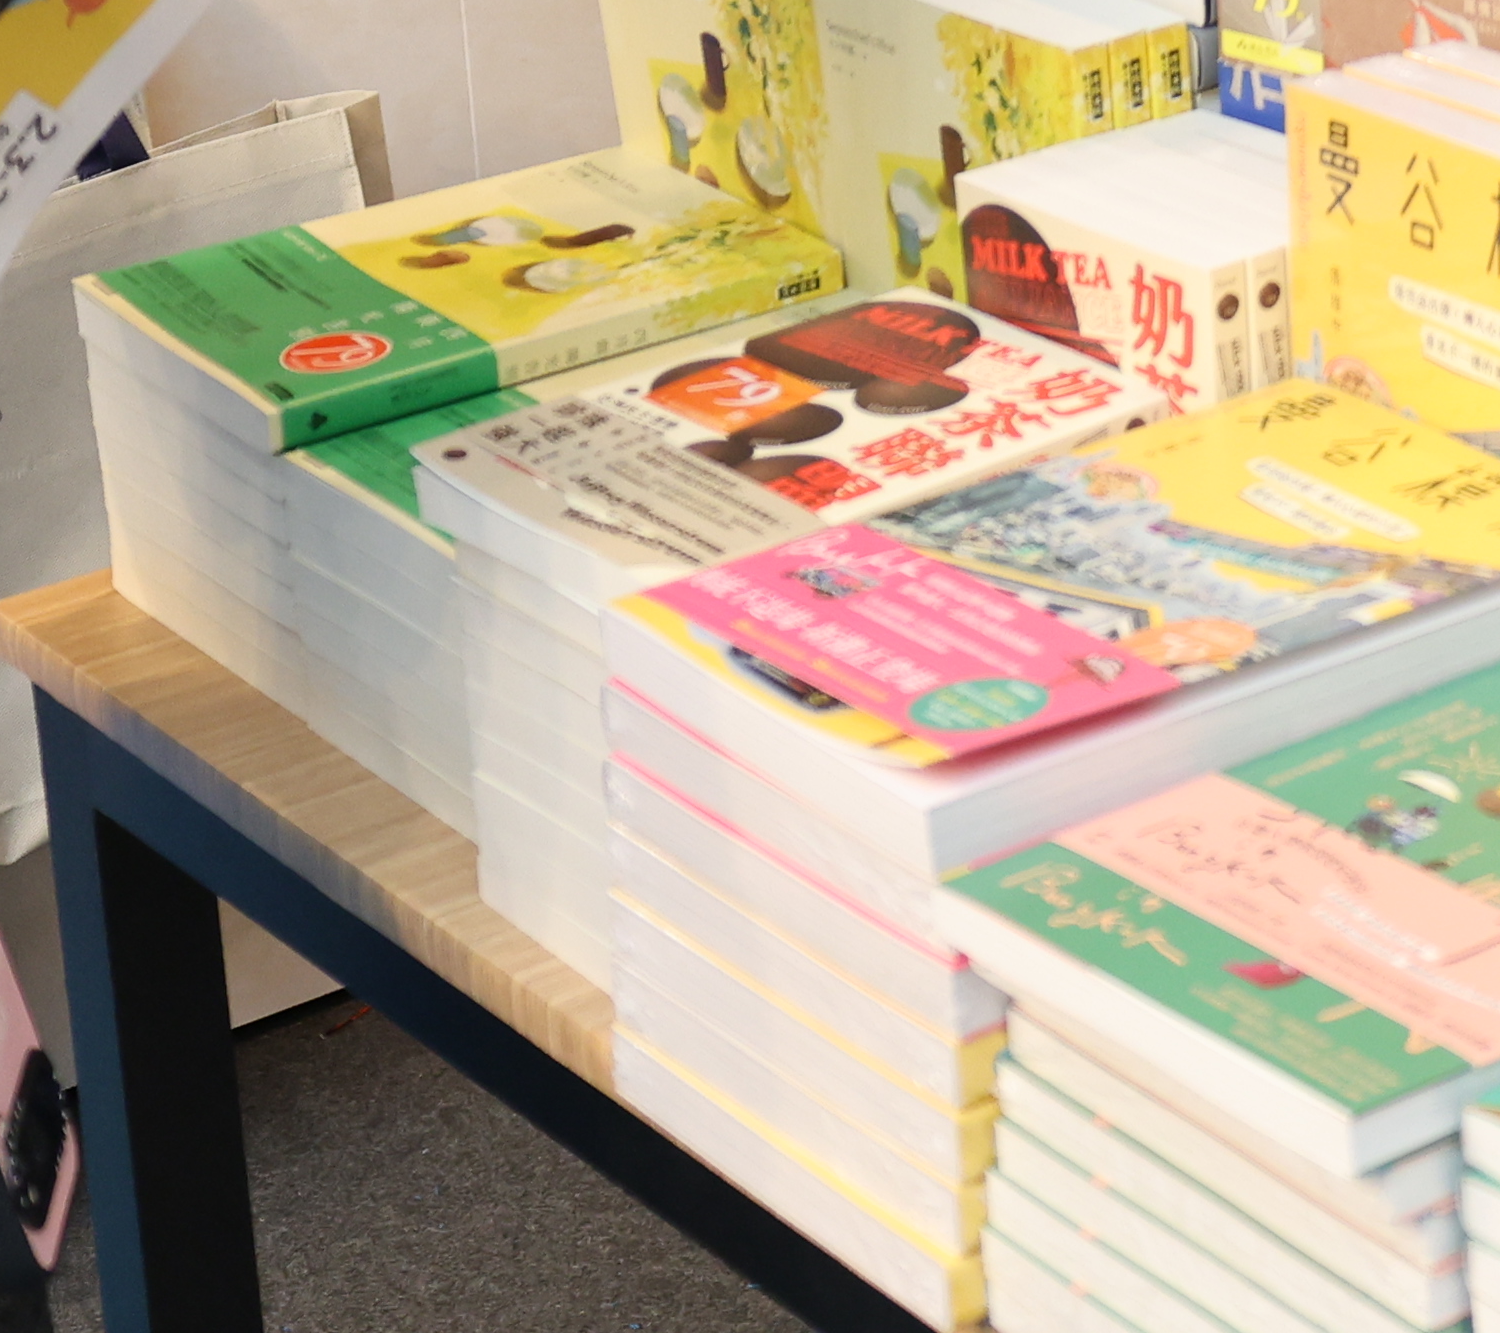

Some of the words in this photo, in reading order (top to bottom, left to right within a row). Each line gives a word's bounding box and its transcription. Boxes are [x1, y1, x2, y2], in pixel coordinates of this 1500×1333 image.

[969, 236, 1048, 283] MILK
[1051, 251, 1113, 291] TEA
[965, 336, 1040, 373] TEA
[683, 366, 780, 408] 79
